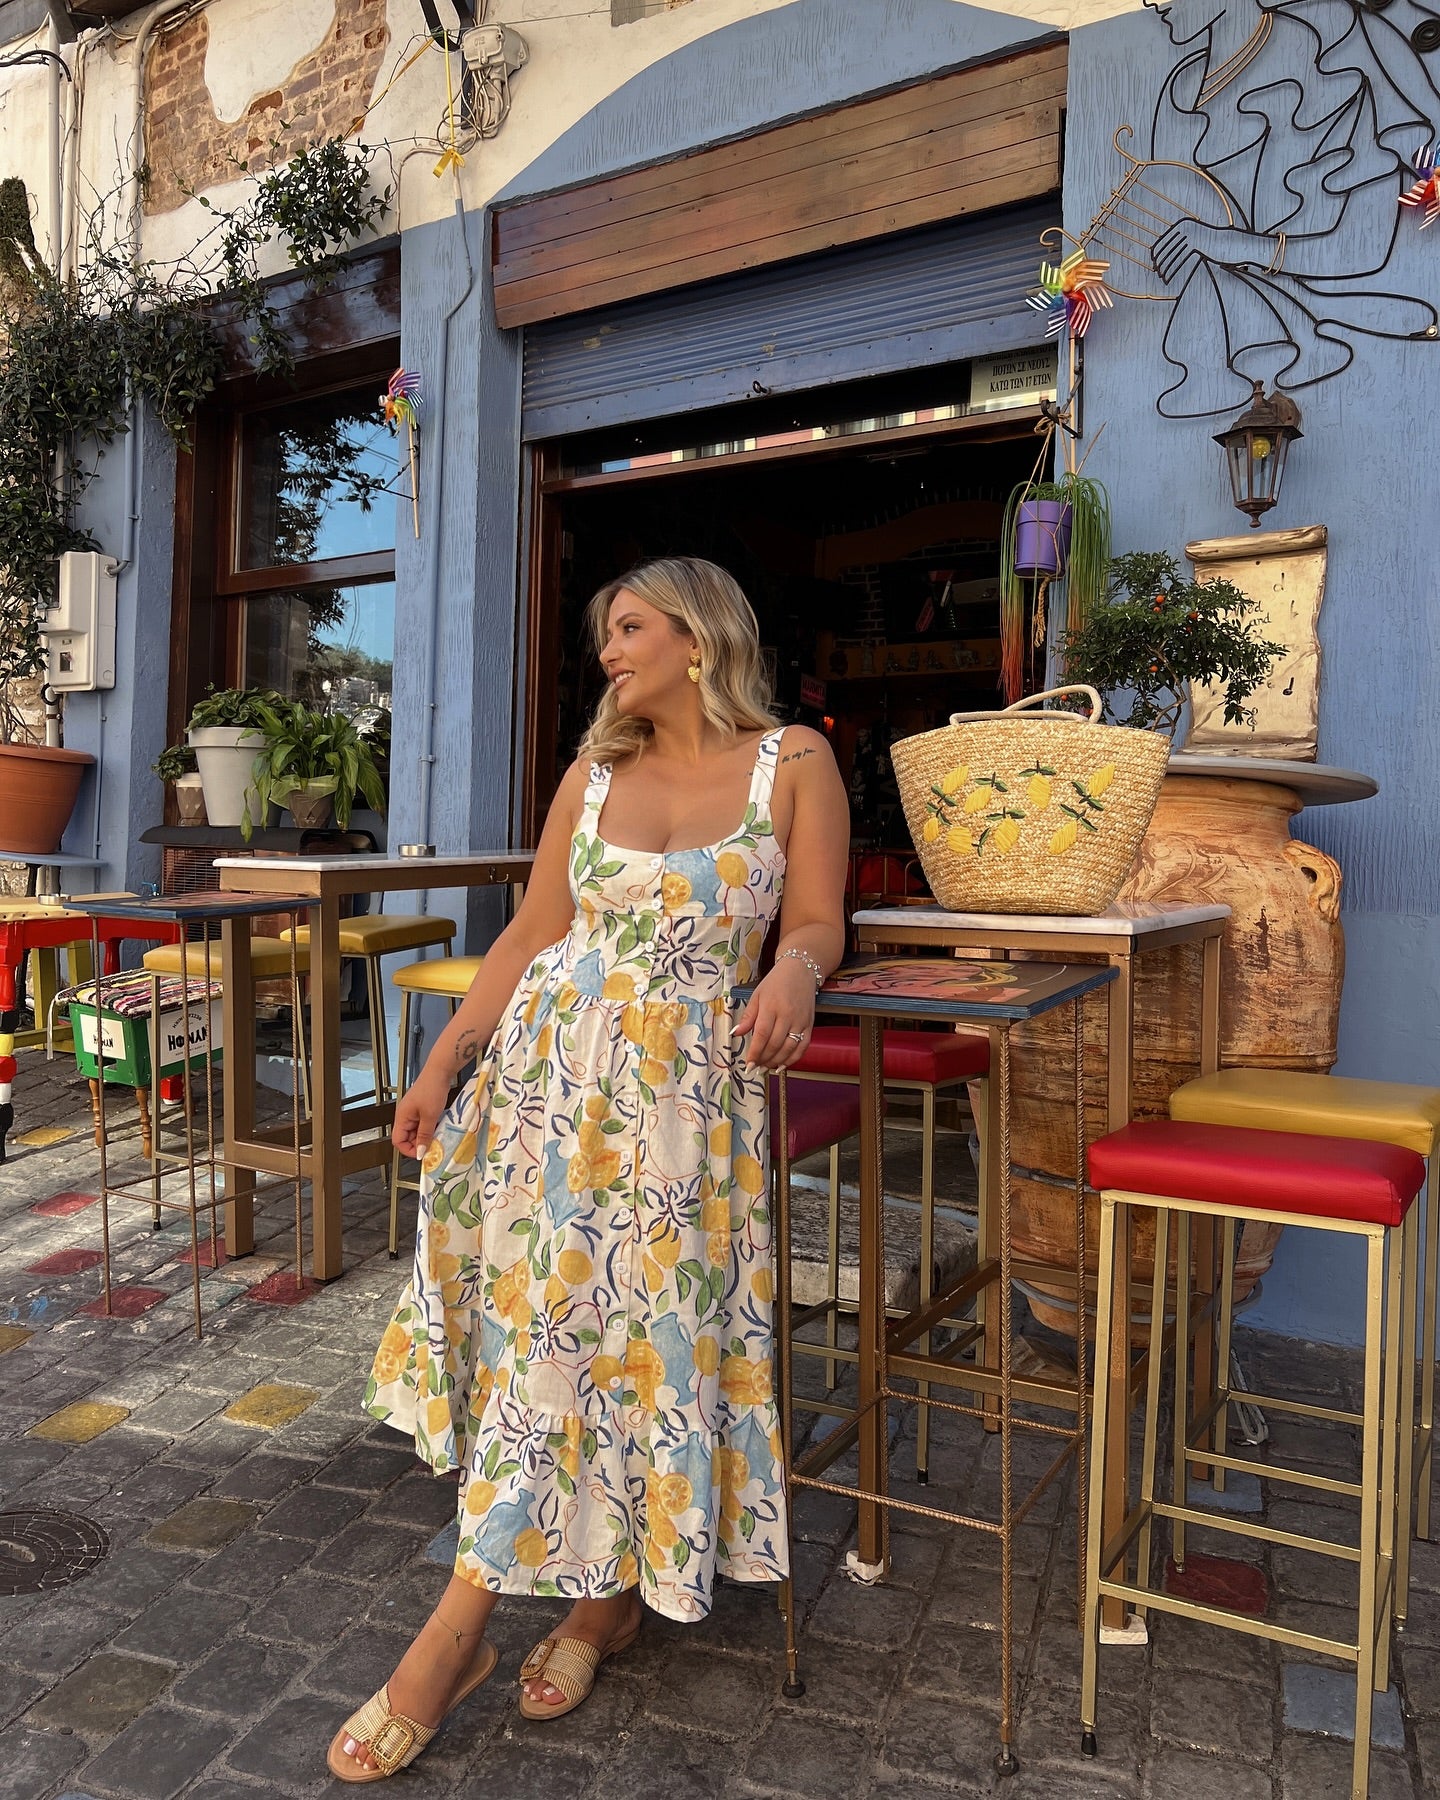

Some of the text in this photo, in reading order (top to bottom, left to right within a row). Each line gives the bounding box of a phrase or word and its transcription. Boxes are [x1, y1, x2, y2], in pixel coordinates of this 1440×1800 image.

[992, 361, 1017, 377] ΠΟΤΩΝ
[1017, 360, 1027, 372] ΣΕ
[990, 372, 1052, 393] ΚΑΤΩ ΤΩΝ 17 ΕΤΩΝ
